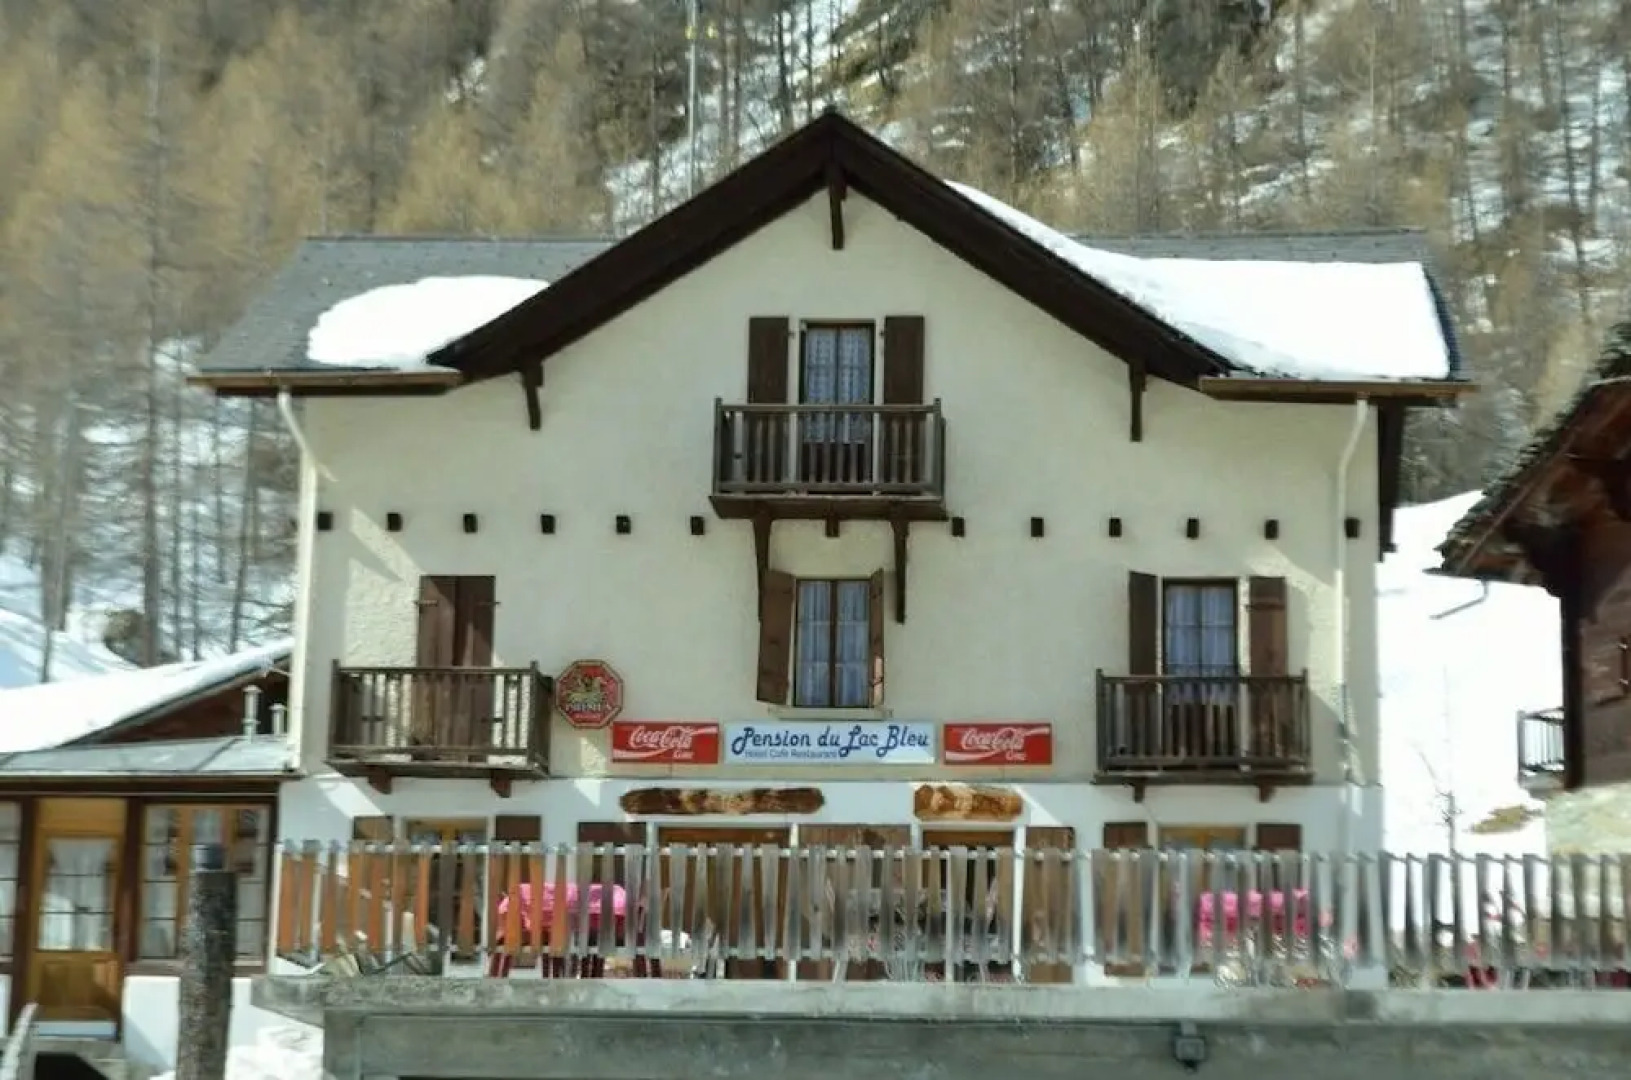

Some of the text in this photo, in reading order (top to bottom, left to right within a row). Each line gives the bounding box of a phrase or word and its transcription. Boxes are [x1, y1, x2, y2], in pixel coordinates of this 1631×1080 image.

[731, 724, 929, 757] Pension du Lac Bleu
